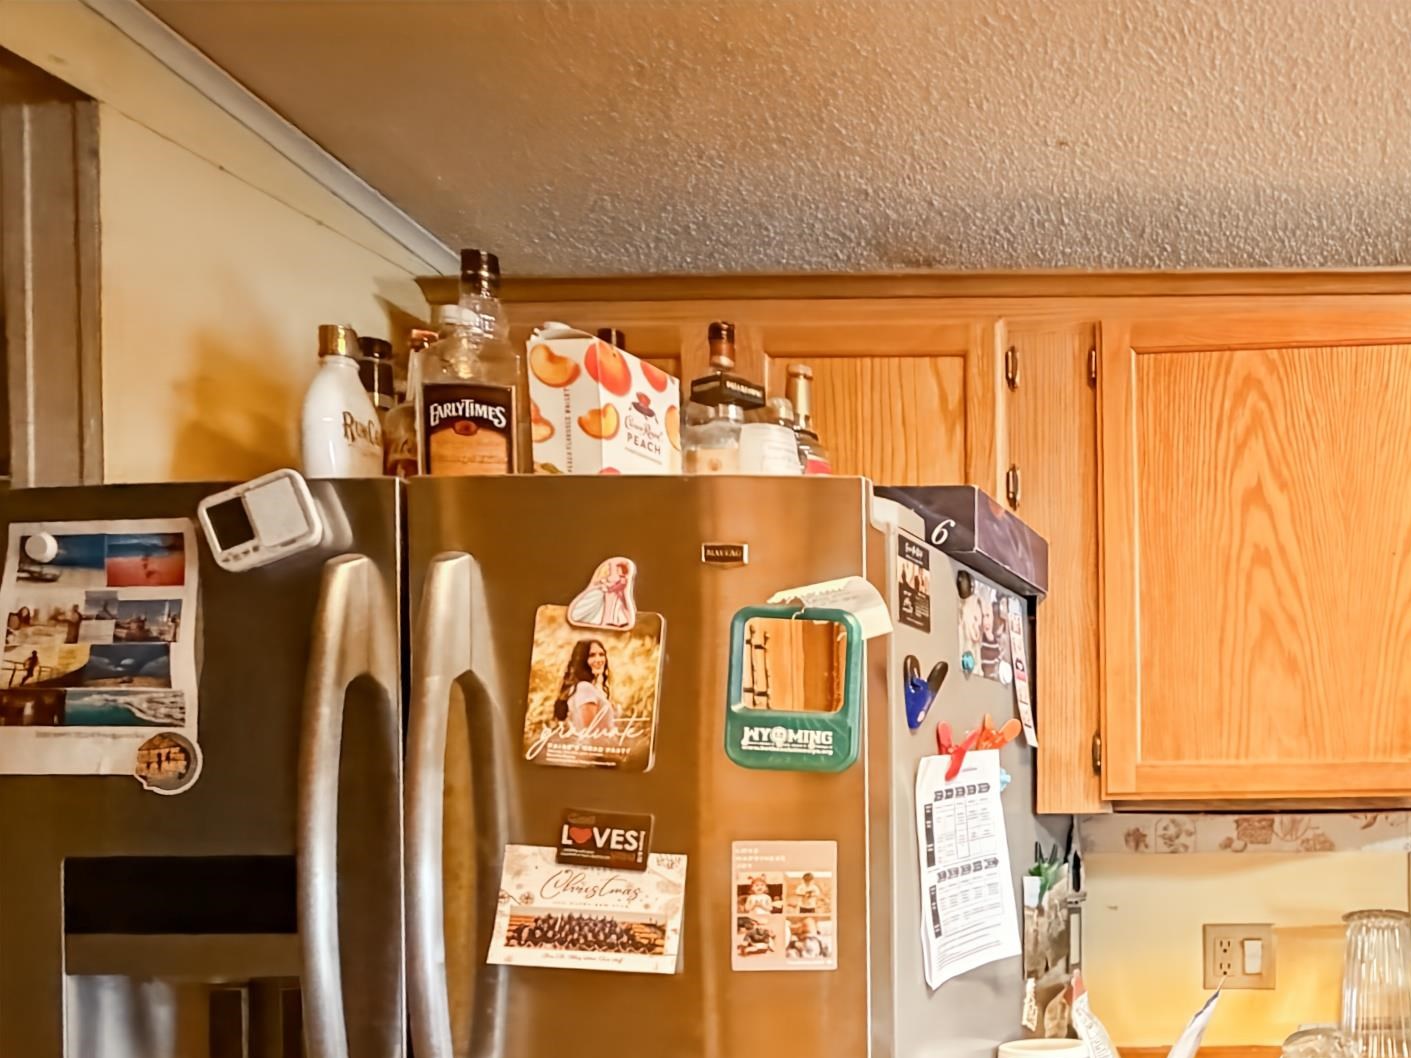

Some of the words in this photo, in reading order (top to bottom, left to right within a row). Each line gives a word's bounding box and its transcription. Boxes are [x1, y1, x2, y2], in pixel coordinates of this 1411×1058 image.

[627, 432, 661, 456] PEACH
[931, 519, 956, 545] 6
[525, 705, 650, 760] graduate
[742, 726, 834, 748] WYOMING
[540, 868, 641, 901] Christmas
